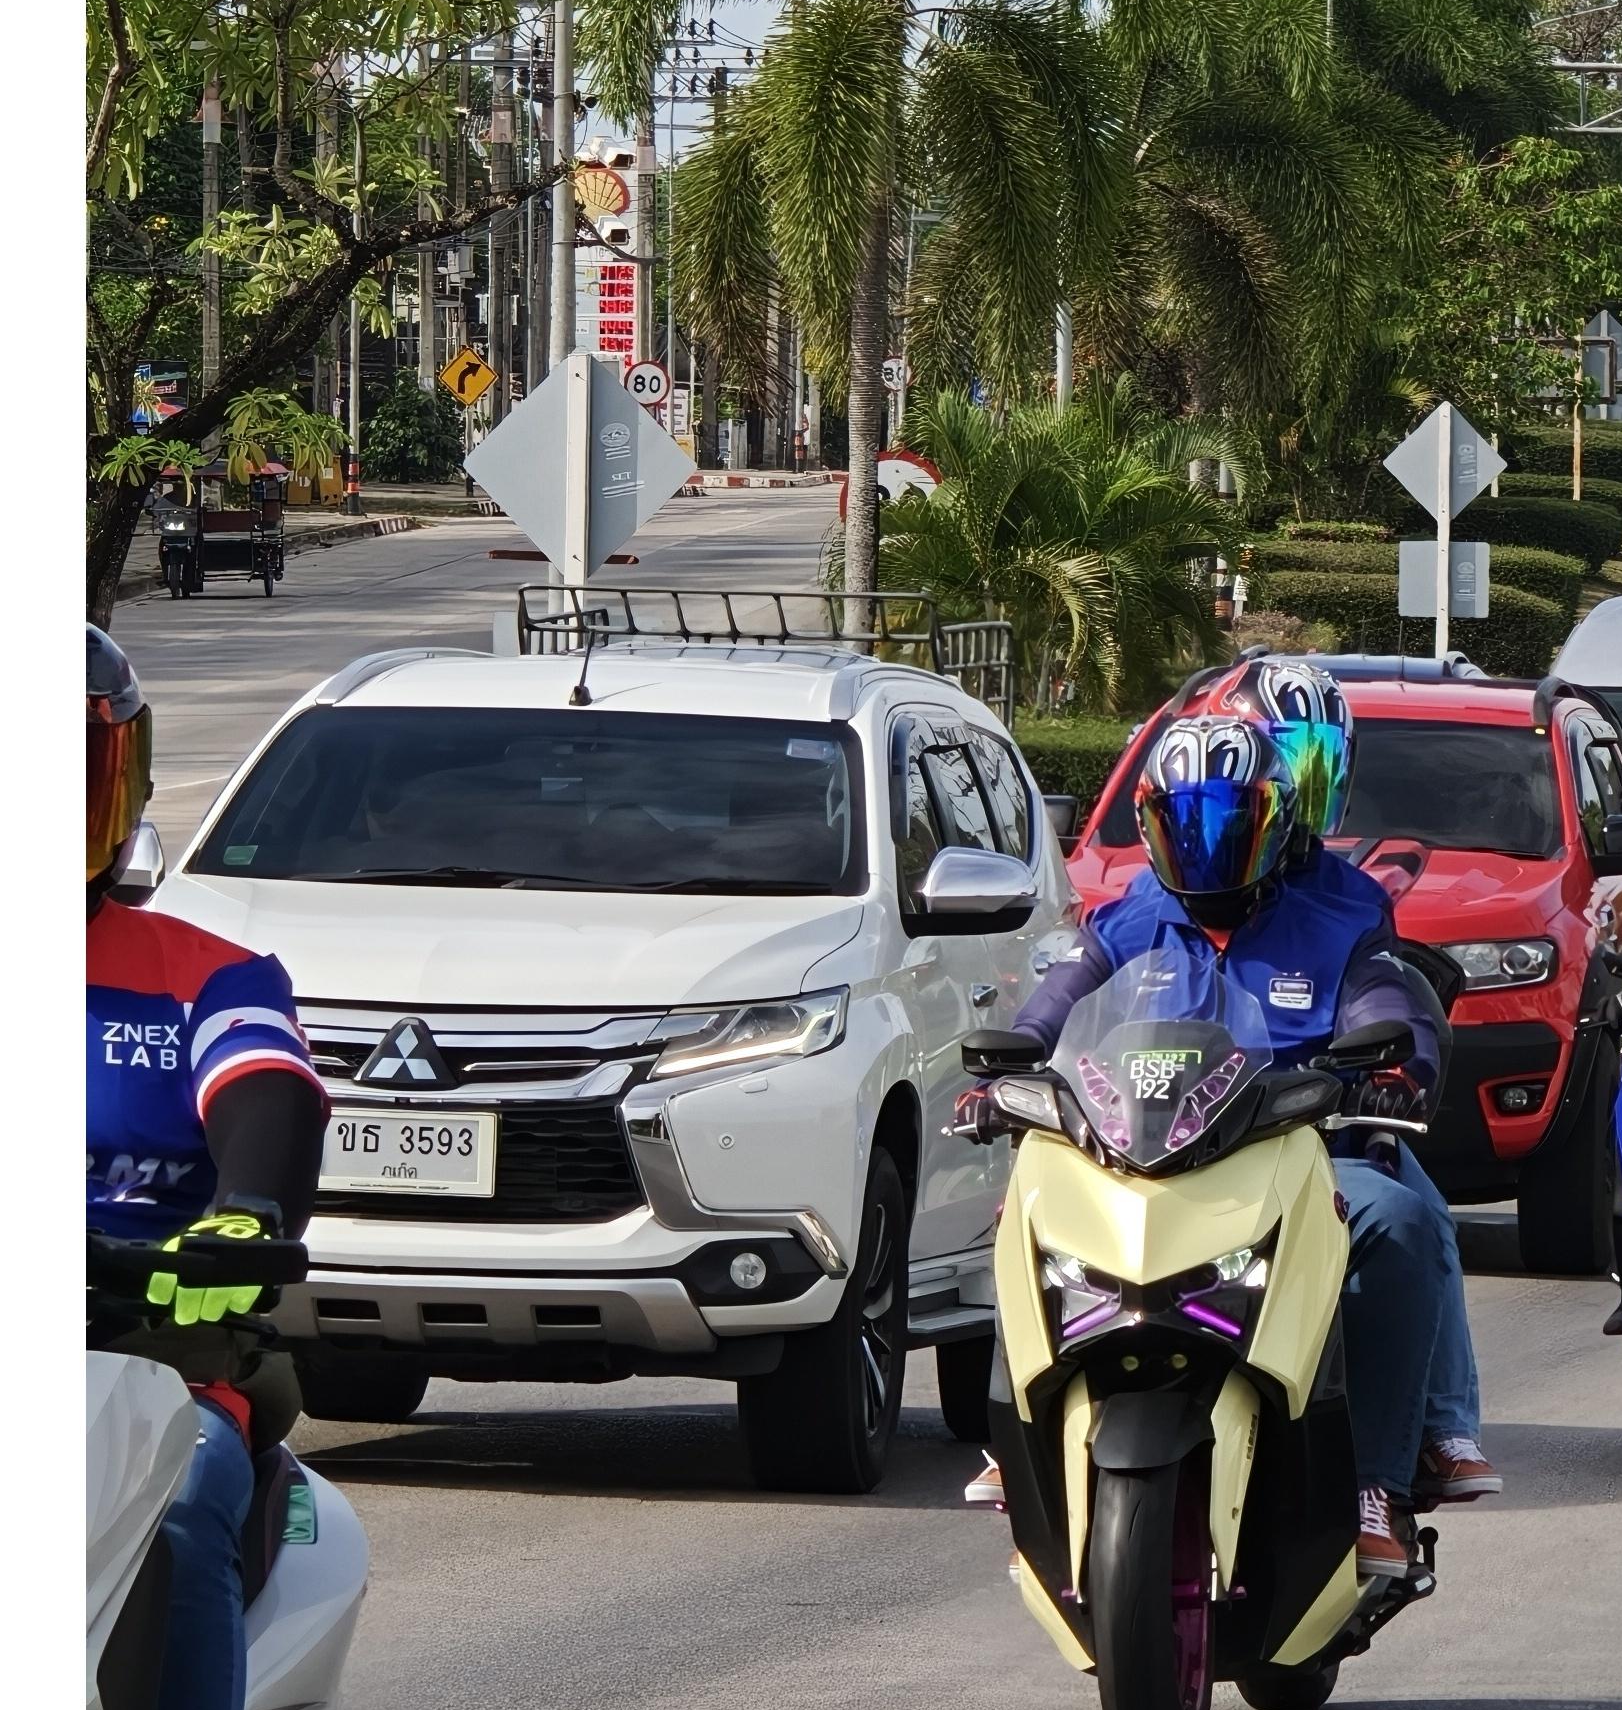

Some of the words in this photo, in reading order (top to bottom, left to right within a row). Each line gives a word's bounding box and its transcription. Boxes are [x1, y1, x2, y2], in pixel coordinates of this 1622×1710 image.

[633, 374, 661, 395] 80
[102, 1021, 181, 1046] ZNEX
[105, 1043, 178, 1070] LAB
[1129, 1058, 1176, 1080] BSB
[1135, 1078, 1171, 1100] 192
[337, 1122, 382, 1153] ขธ
[399, 1125, 474, 1157] 3593
